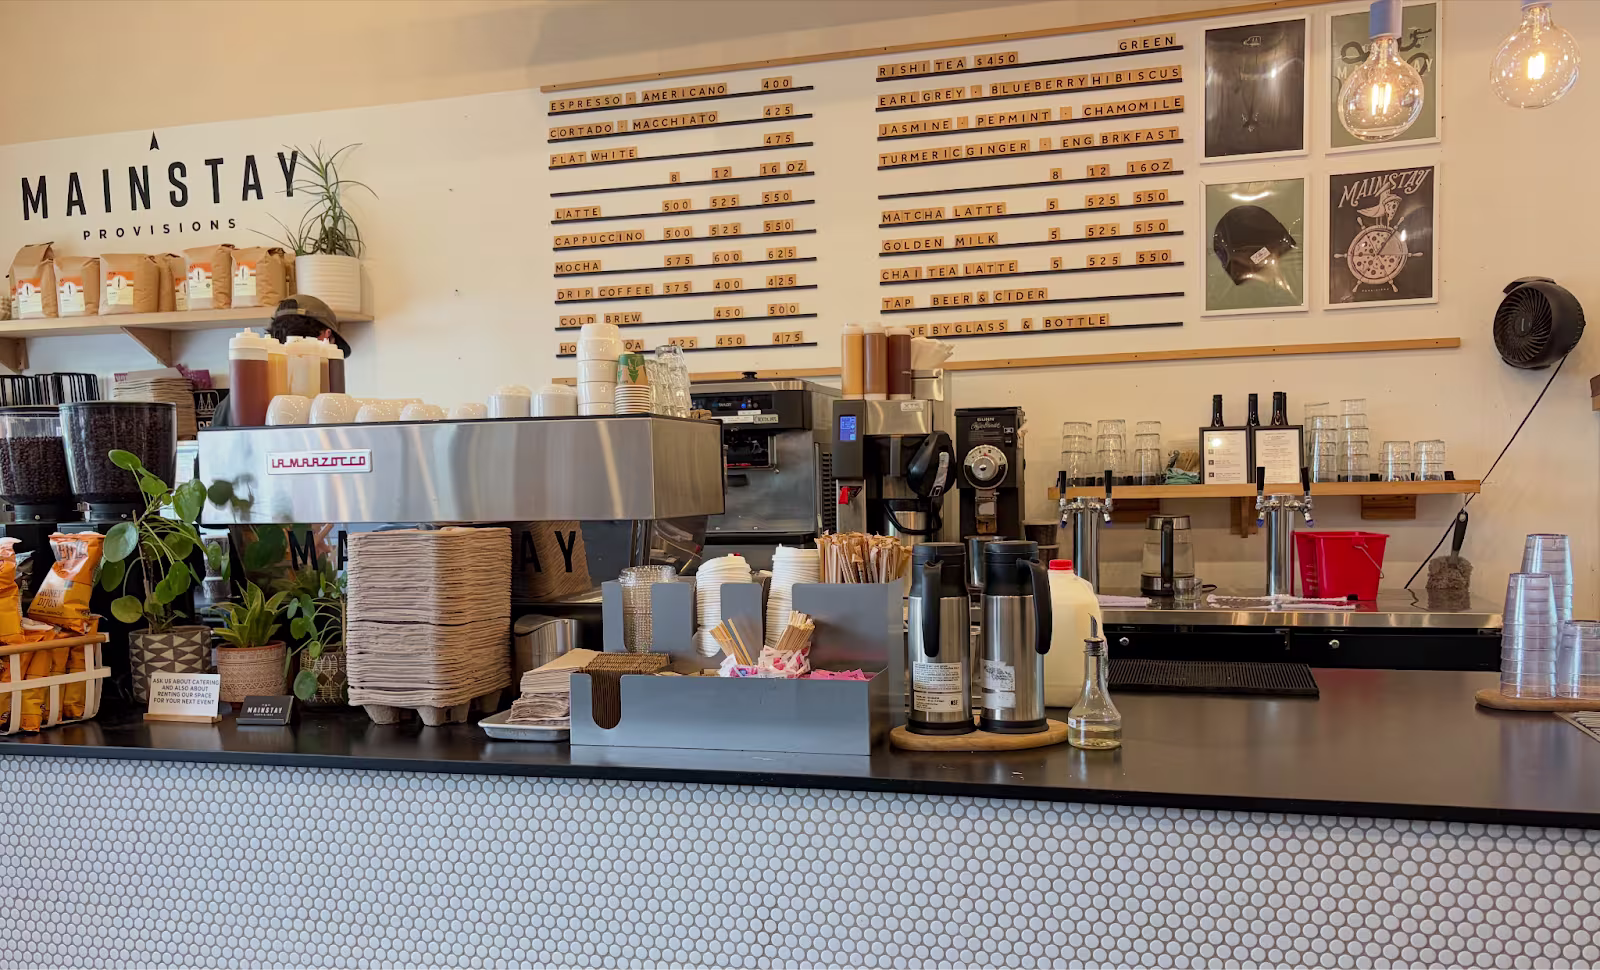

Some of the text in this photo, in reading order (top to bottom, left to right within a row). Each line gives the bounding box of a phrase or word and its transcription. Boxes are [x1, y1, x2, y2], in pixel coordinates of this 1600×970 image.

[879, 36, 1174, 77] RISHI TEA $450 GREEN
[551, 79, 790, 111] ESPRESSO AMERICANO 400
[880, 68, 1180, 106] EARL GREY BLUEBERRY HIBISCUS
[550, 106, 791, 138] CORTADO MACCHIATO 425
[881, 97, 1182, 136] JASMINE PEPMINT CHAMOMILE
[552, 134, 791, 165] FLAT WHITE 475
[880, 129, 1177, 165] TURMERIC GINGER ENG BRKFAST
[21, 150, 299, 221] MAINSTAY
[671, 162, 805, 183] 8 12 16 OZ
[1052, 171, 1059, 180] 8
[1090, 166, 1107, 177] 12
[1338, 168, 1432, 208] MAINSTAY
[556, 192, 790, 219] LATTE 500 525 550
[882, 192, 1166, 223] MATCHA LATTE 5 525 550
[83, 218, 237, 240] PROVISIONS
[554, 221, 791, 246] CAPPUCCINO 500 525 550
[883, 222, 1166, 251] GOLDEN MILK 5 525 550
[555, 249, 794, 273] MOCHA 575 600 625
[882, 252, 1168, 281] CHAI TEA LATTE 5 525 550
[557, 276, 794, 300] DRIP COFFEE 375 400 425
[884, 290, 1045, 310] TAP BEER & CIDER
[560, 304, 796, 326] COLD BREW 450 500
[1023, 320, 1031, 330] &
[1045, 316, 1106, 328] BOTTLE
[717, 336, 742, 347] 450
[774, 333, 800, 344] 475
[37, 597, 59, 609] DIJON
[39, 588, 64, 598] HONEY
[247, 706, 283, 714] MAINSTAY
